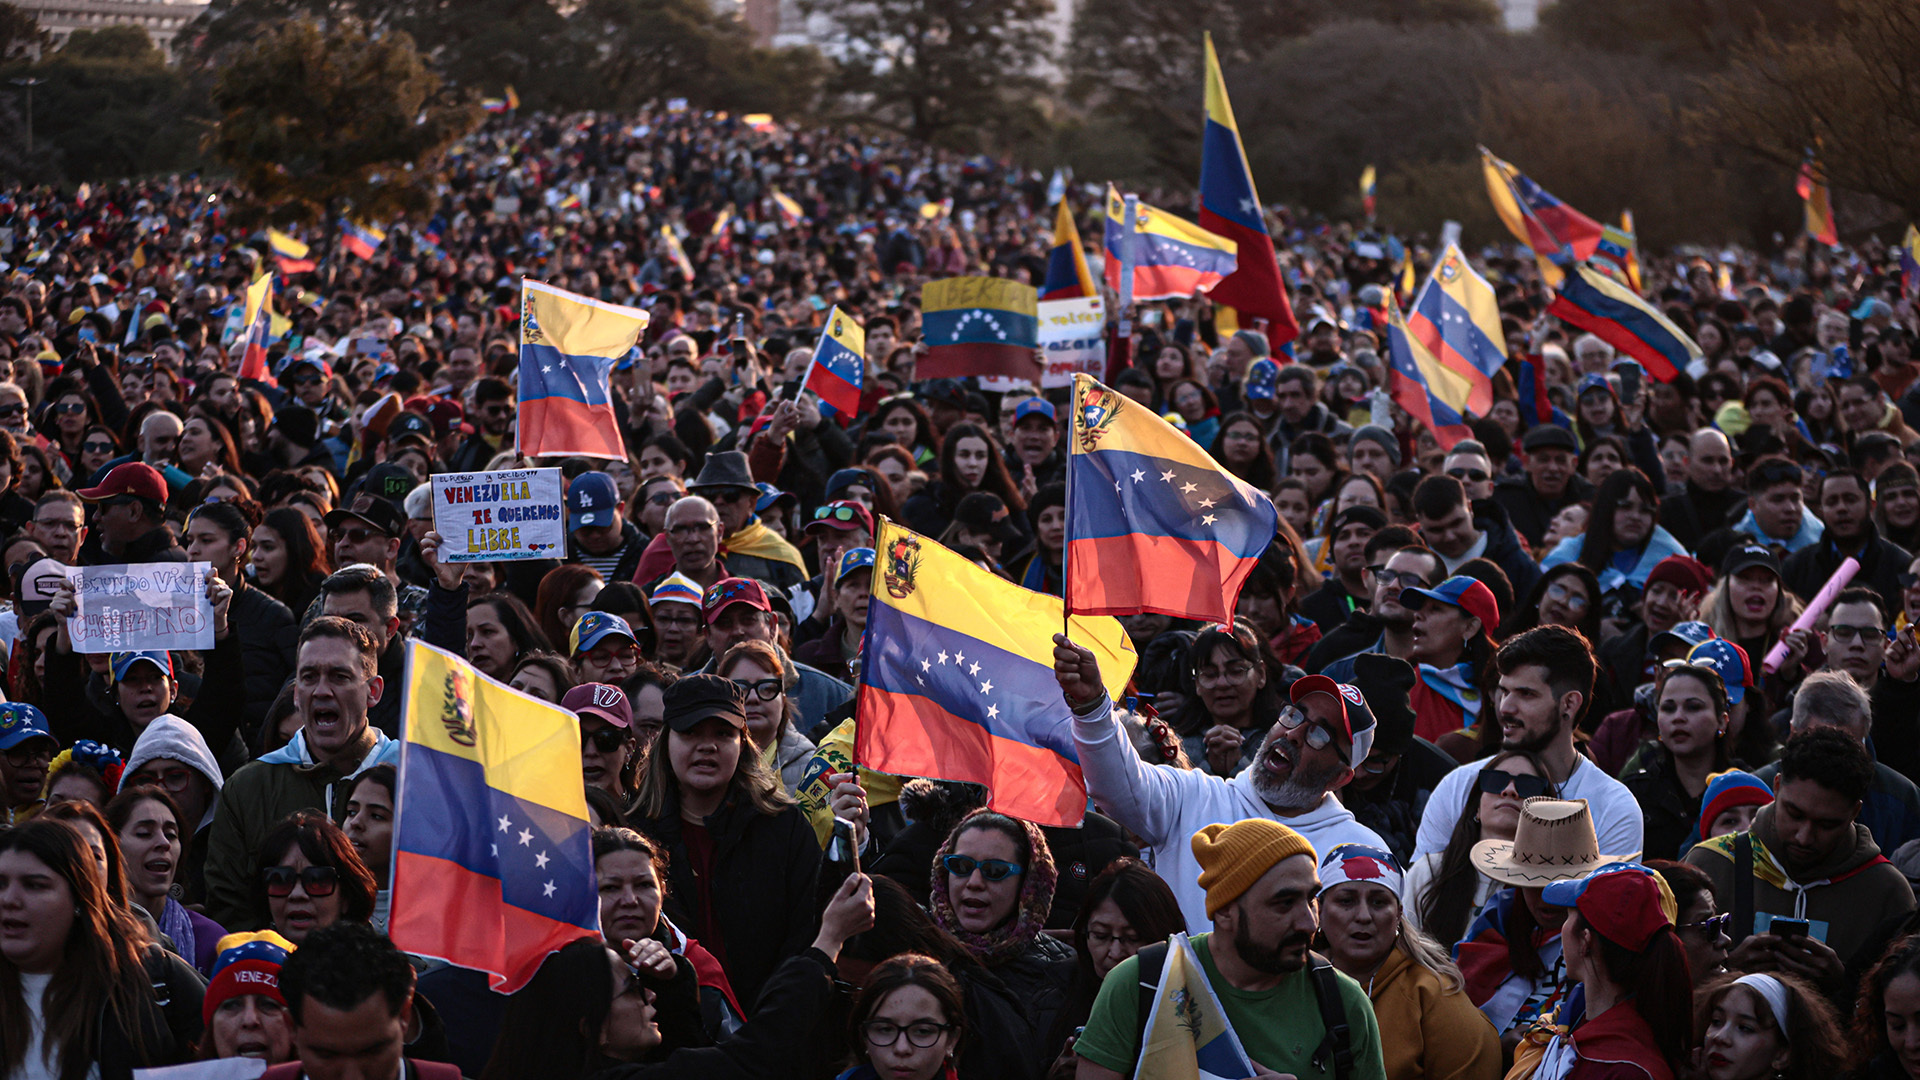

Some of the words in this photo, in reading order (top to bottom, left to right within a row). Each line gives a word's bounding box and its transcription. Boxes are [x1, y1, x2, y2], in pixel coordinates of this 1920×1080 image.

[444, 481, 531, 504] VENEZUELA
[472, 508, 492, 525] TE
[498, 504, 560, 523] QUEREMOS
[72, 609, 148, 642] CHAVEZ
[156, 606, 206, 636] NO
[233, 970, 279, 988] VENEZU
